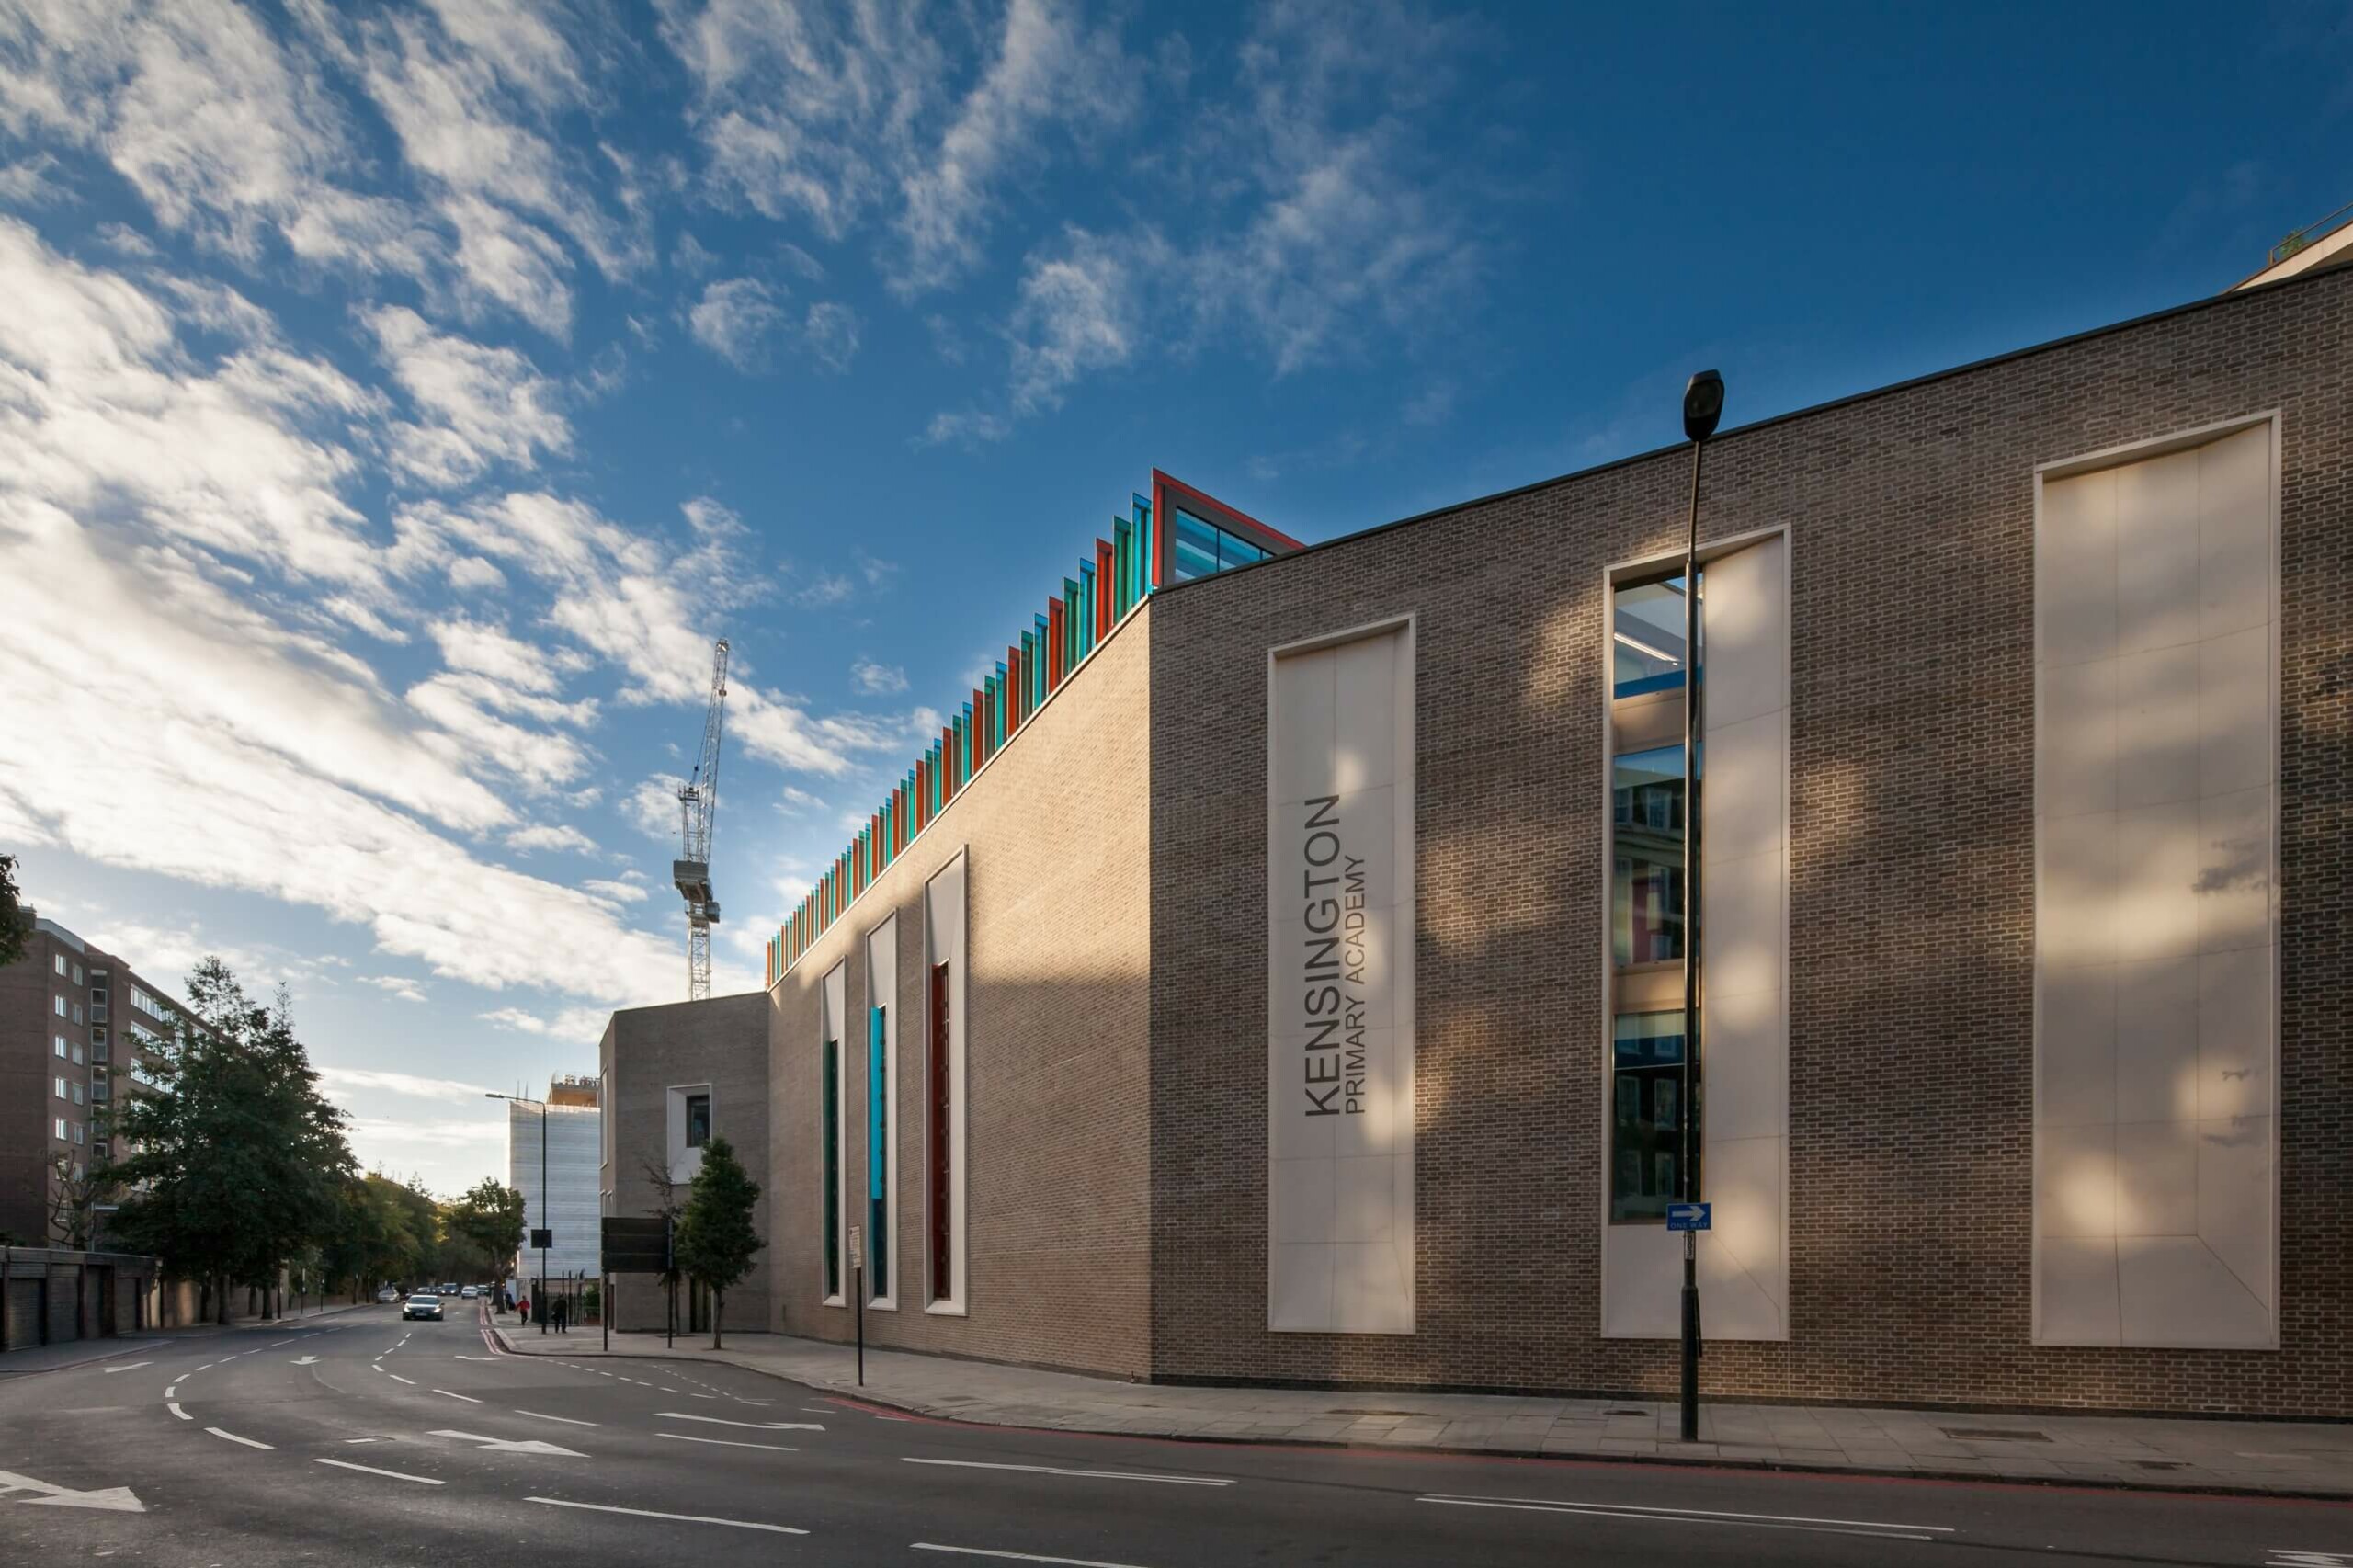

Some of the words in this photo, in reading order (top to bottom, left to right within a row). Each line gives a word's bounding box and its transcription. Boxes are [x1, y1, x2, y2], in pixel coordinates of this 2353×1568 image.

[1304, 794, 1341, 1117] KENSINGTON
[1345, 855, 1366, 985] ACADEMY
[1345, 994, 1366, 1115] PRIMARY
